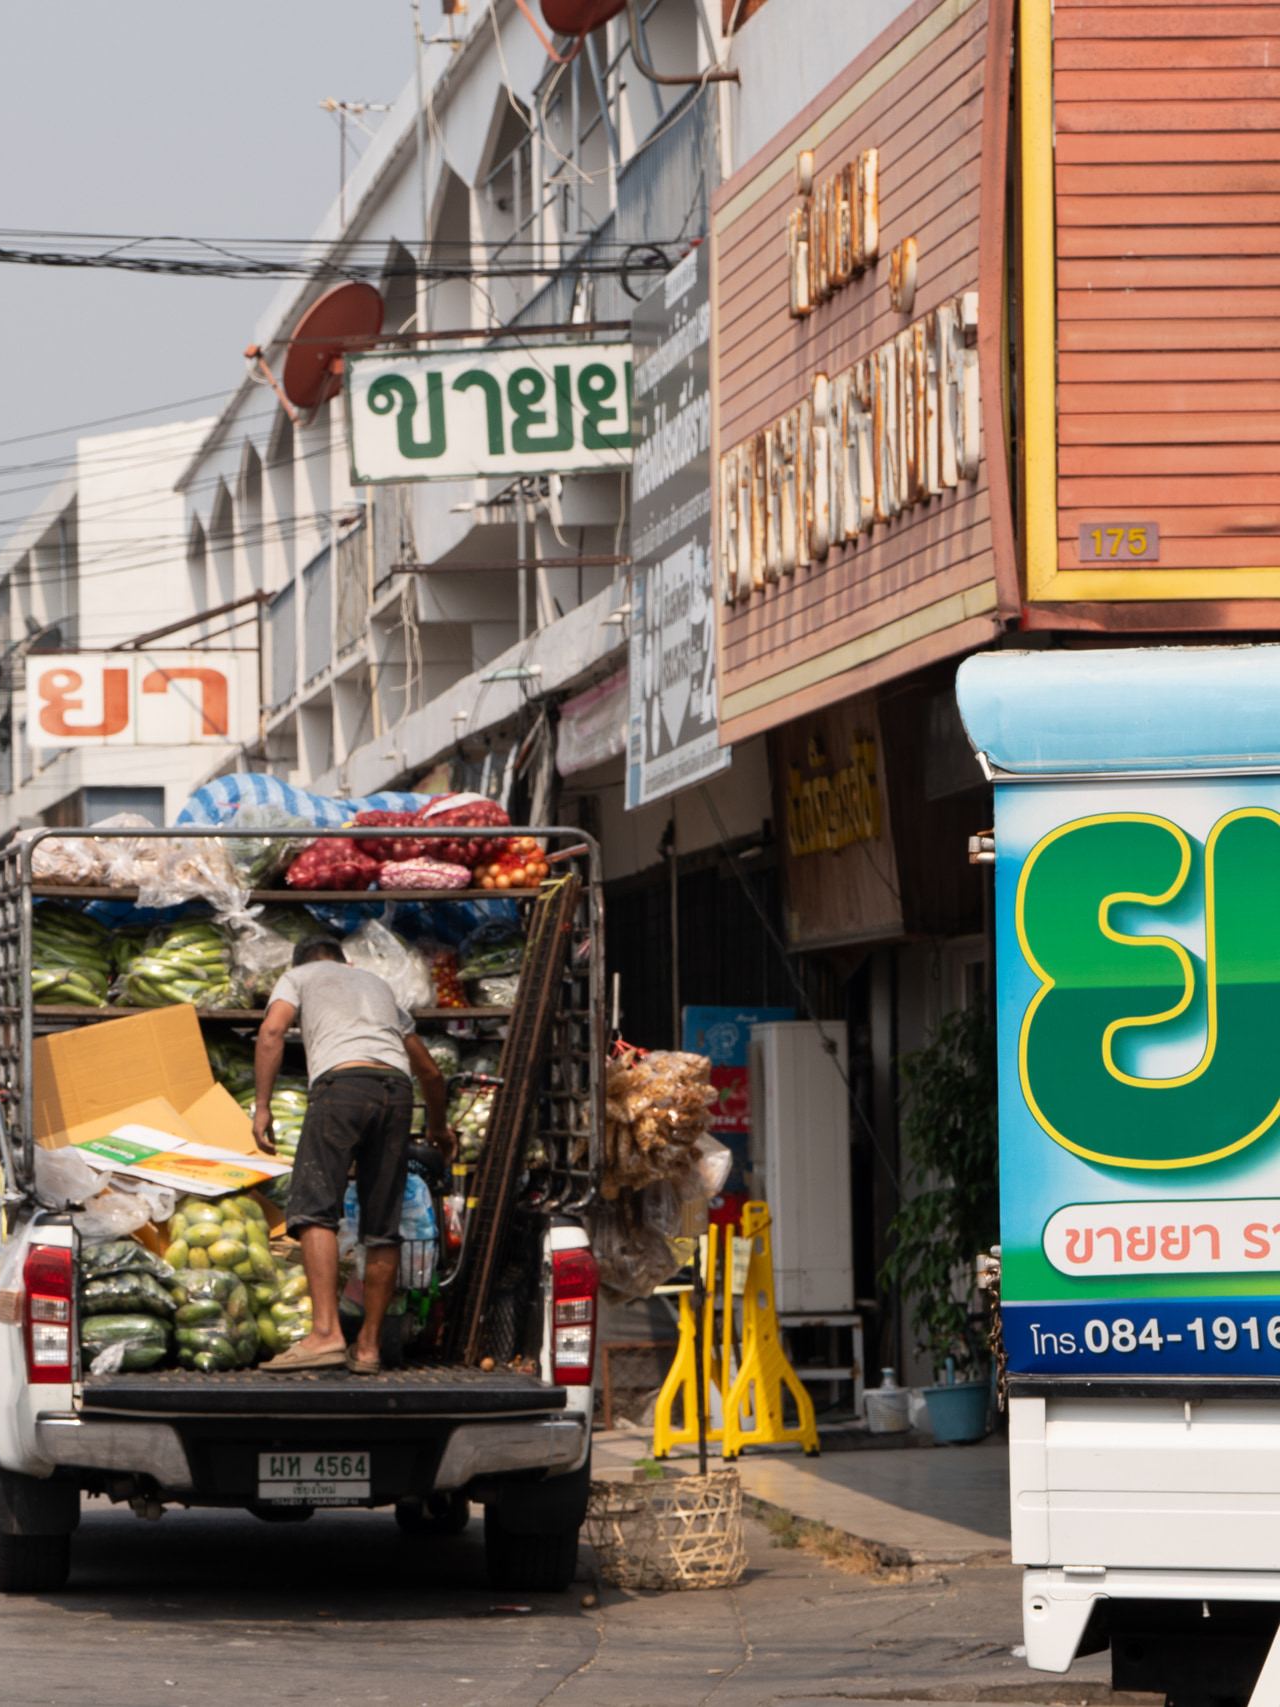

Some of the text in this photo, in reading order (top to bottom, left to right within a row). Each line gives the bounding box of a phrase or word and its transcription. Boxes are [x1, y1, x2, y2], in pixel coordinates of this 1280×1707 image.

[1091, 528, 1147, 557] 175
[38, 666, 229, 737] ยา
[1065, 1223, 1221, 1265] ขายยา
[313, 1455, 367, 1477] 4564
